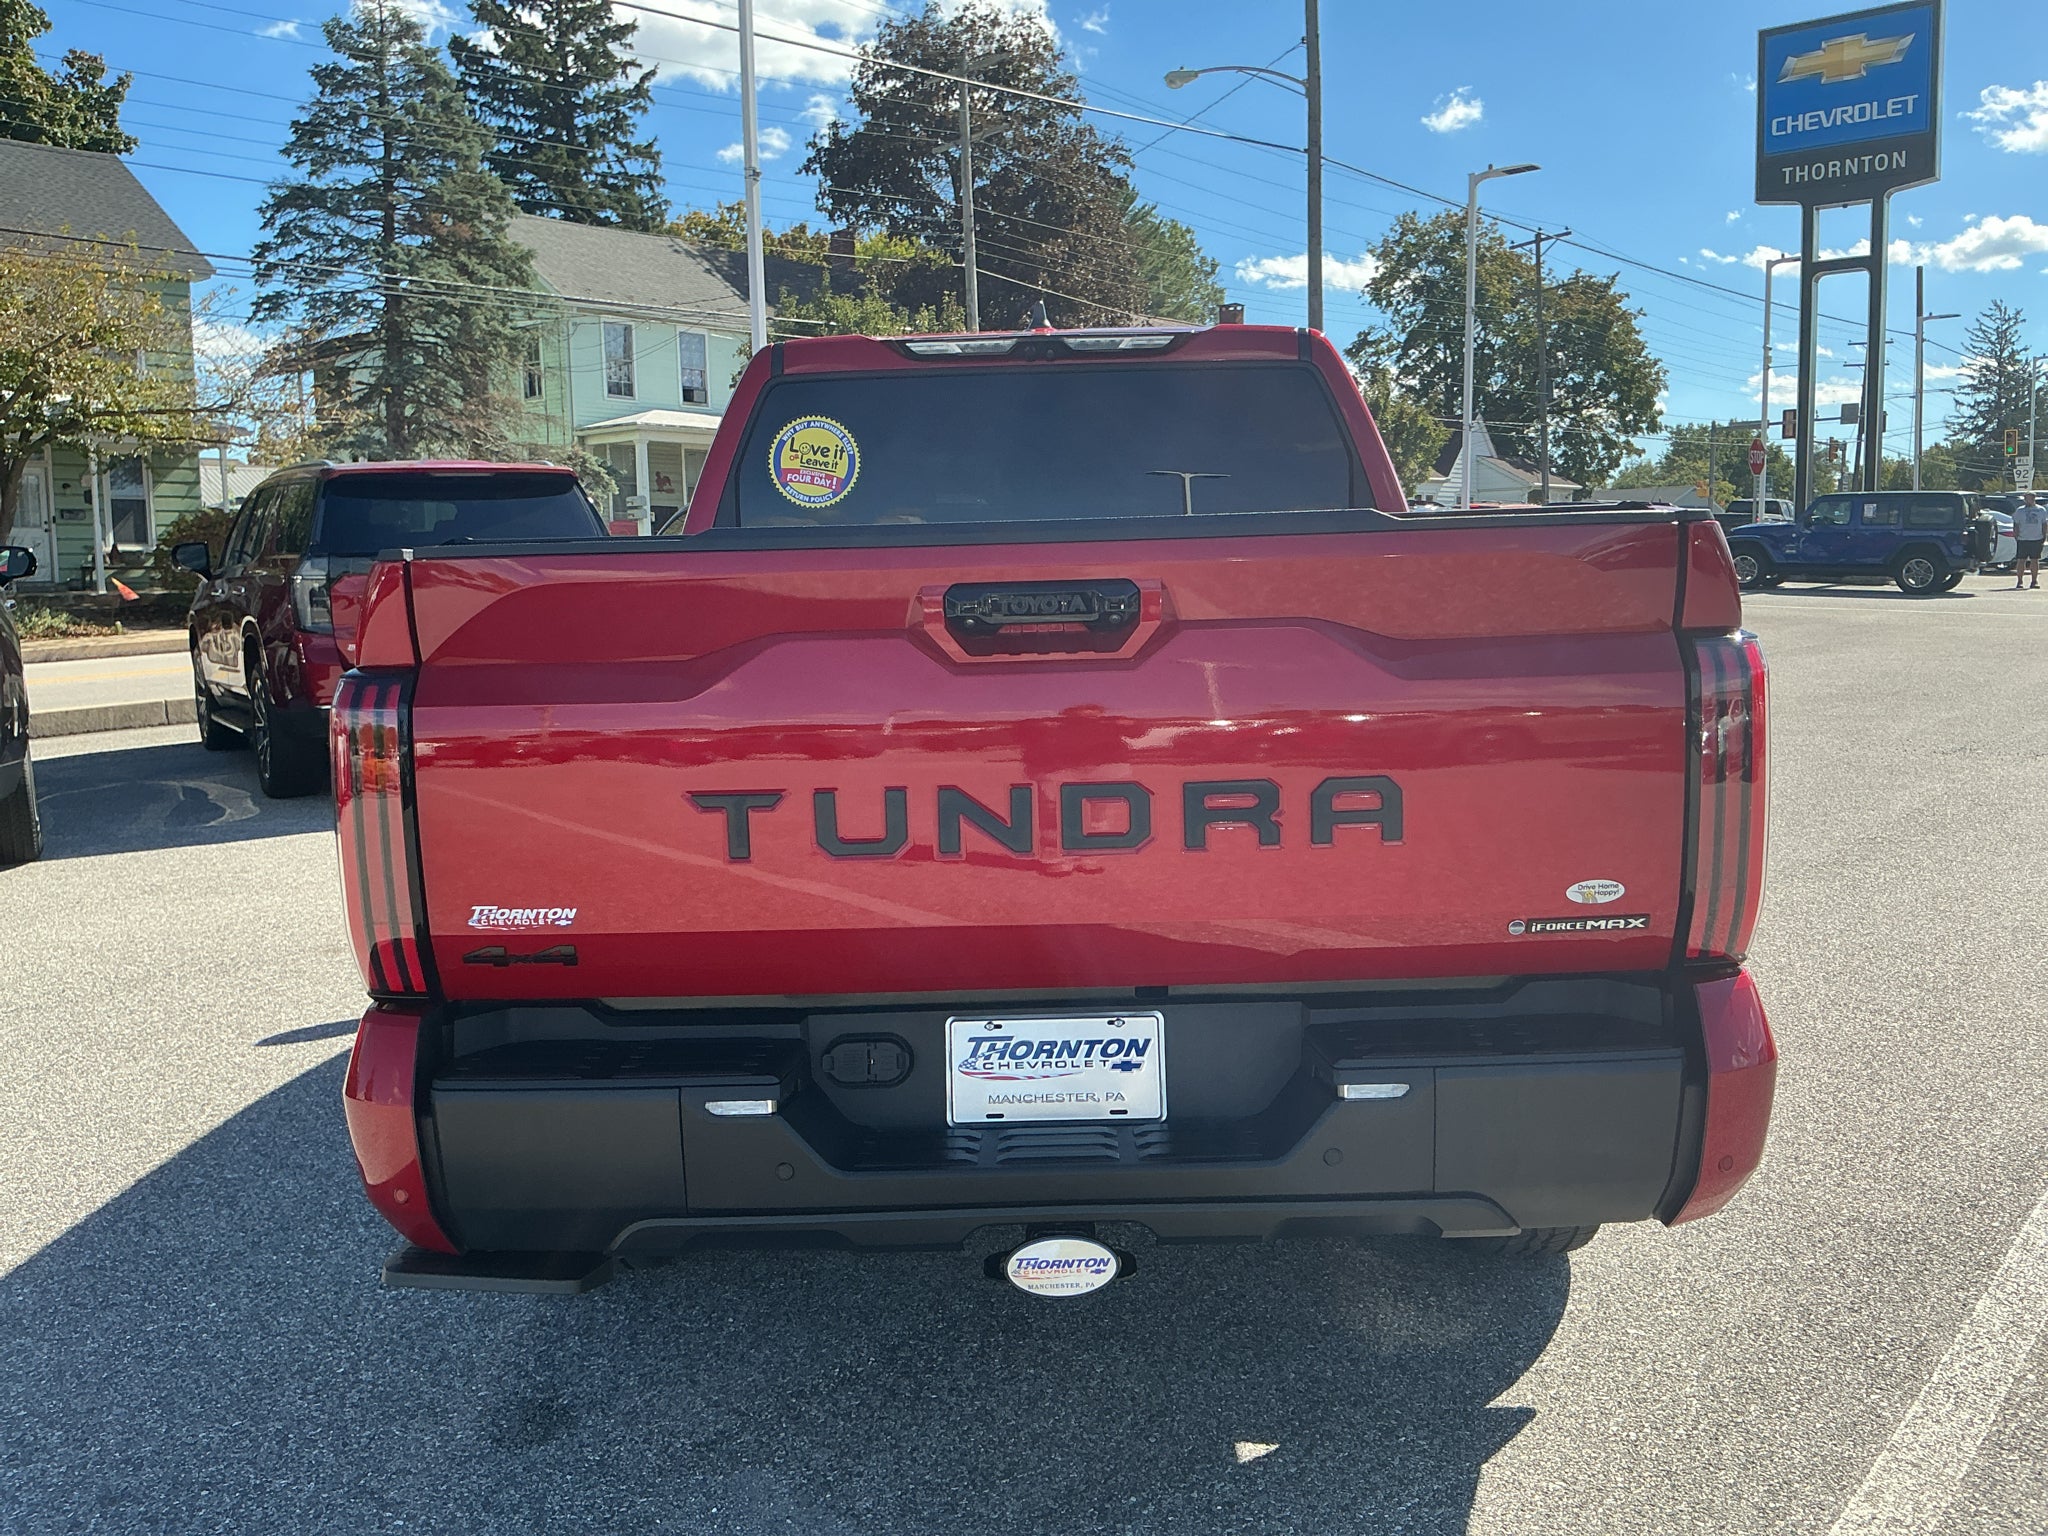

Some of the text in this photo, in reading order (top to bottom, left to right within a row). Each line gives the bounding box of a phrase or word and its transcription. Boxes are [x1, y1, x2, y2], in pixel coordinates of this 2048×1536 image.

[1771, 94, 1919, 136] CHEVROLET
[1782, 150, 1907, 184] THORNTON
[782, 421, 854, 455] WHY BUY ANYWHERE ELSE?
[789, 437, 846, 460] Love it
[800, 454, 830, 468] Leave
[831, 461, 839, 470] it
[1750, 450, 1765, 464] STOP
[786, 473, 812, 484] FOUR
[2015, 469, 2029, 479] 92
[785, 486, 834, 503] RETURN POLICY
[998, 594, 1087, 614] TOYOTA
[687, 775, 1404, 862] TUNDRA
[1594, 889, 1620, 897] Happy!
[471, 905, 578, 920] THORNTON
[967, 1035, 1152, 1061] THORNTON
[982, 1059, 1110, 1071] CHEVROLET
[988, 1091, 1126, 1105] MANCHESTER, PA
[1016, 1257, 1111, 1270] THORNTON
